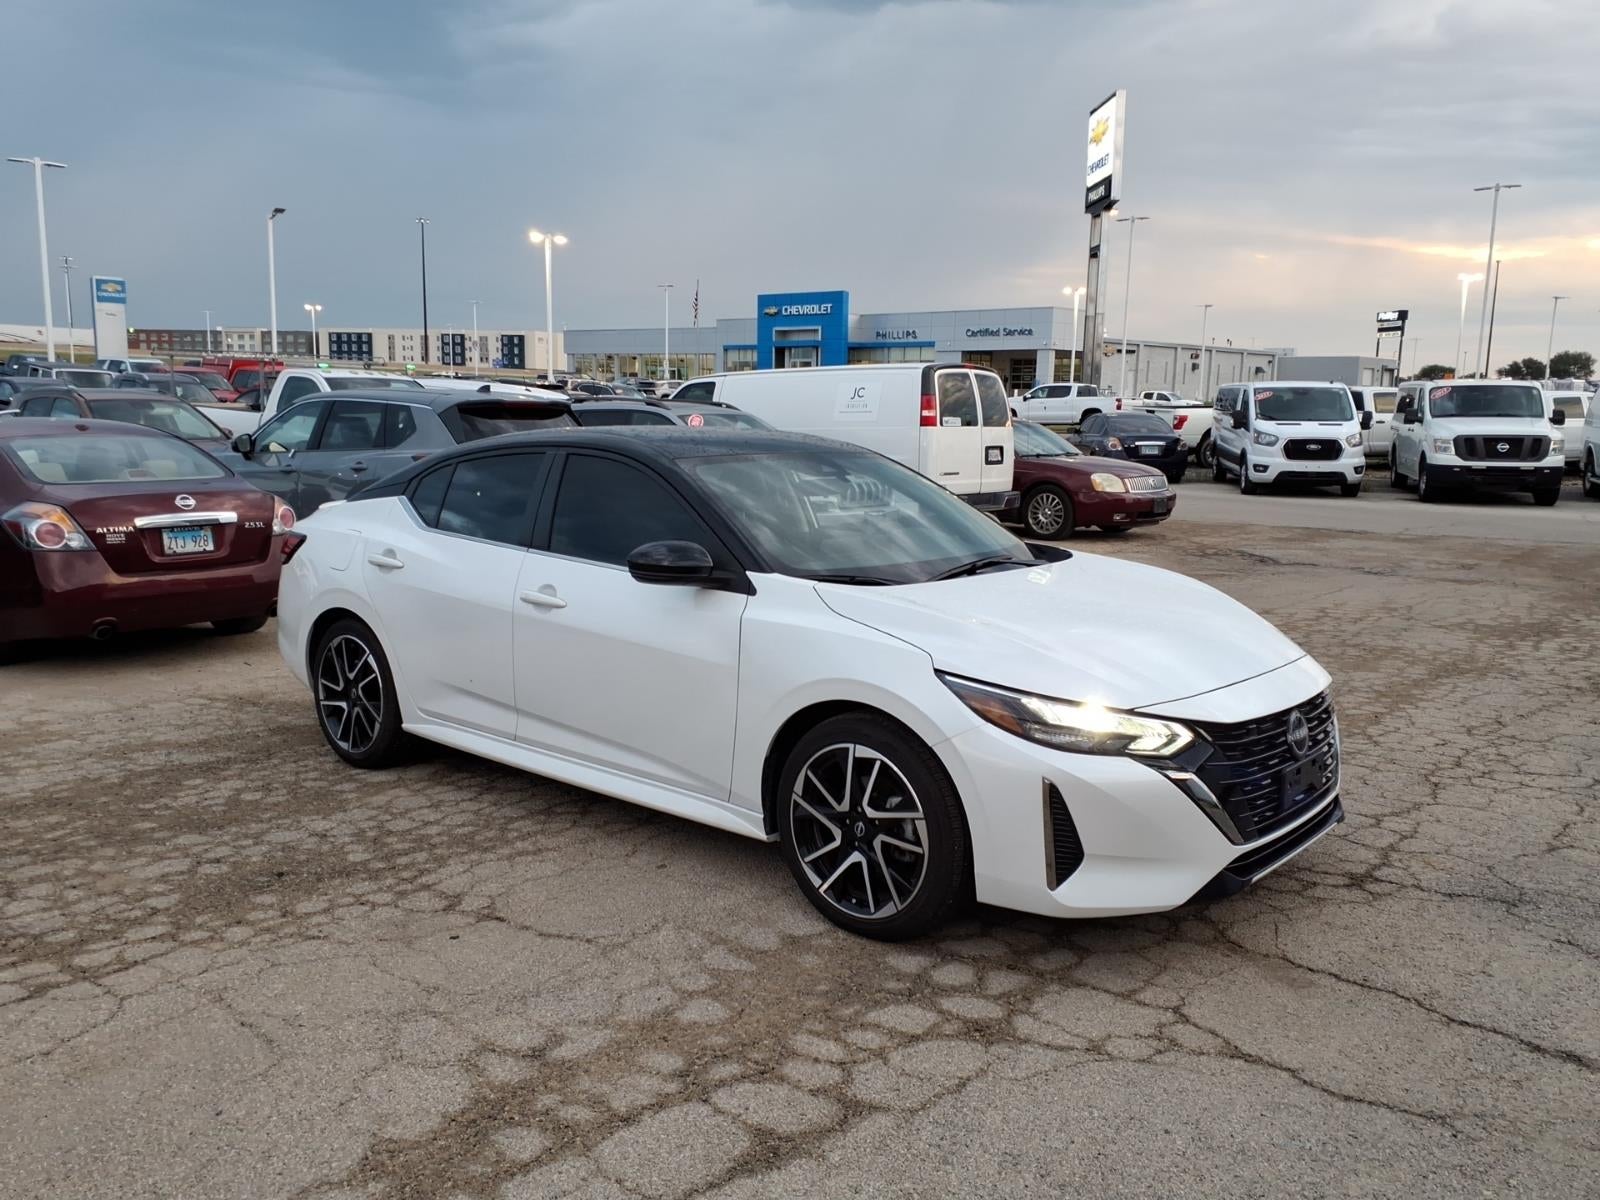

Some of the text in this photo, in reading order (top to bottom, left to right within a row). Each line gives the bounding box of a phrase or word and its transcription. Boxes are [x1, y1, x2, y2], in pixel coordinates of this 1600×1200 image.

[1087, 153, 1110, 176] CHEVROLET
[782, 303, 833, 316] CHEVROLET
[875, 329, 919, 340] PHILLIPS
[965, 326, 1034, 338] Certified Service
[850, 386, 866, 400] JC
[95, 525, 135, 534] ALTIMA
[191, 534, 210, 548] 928
